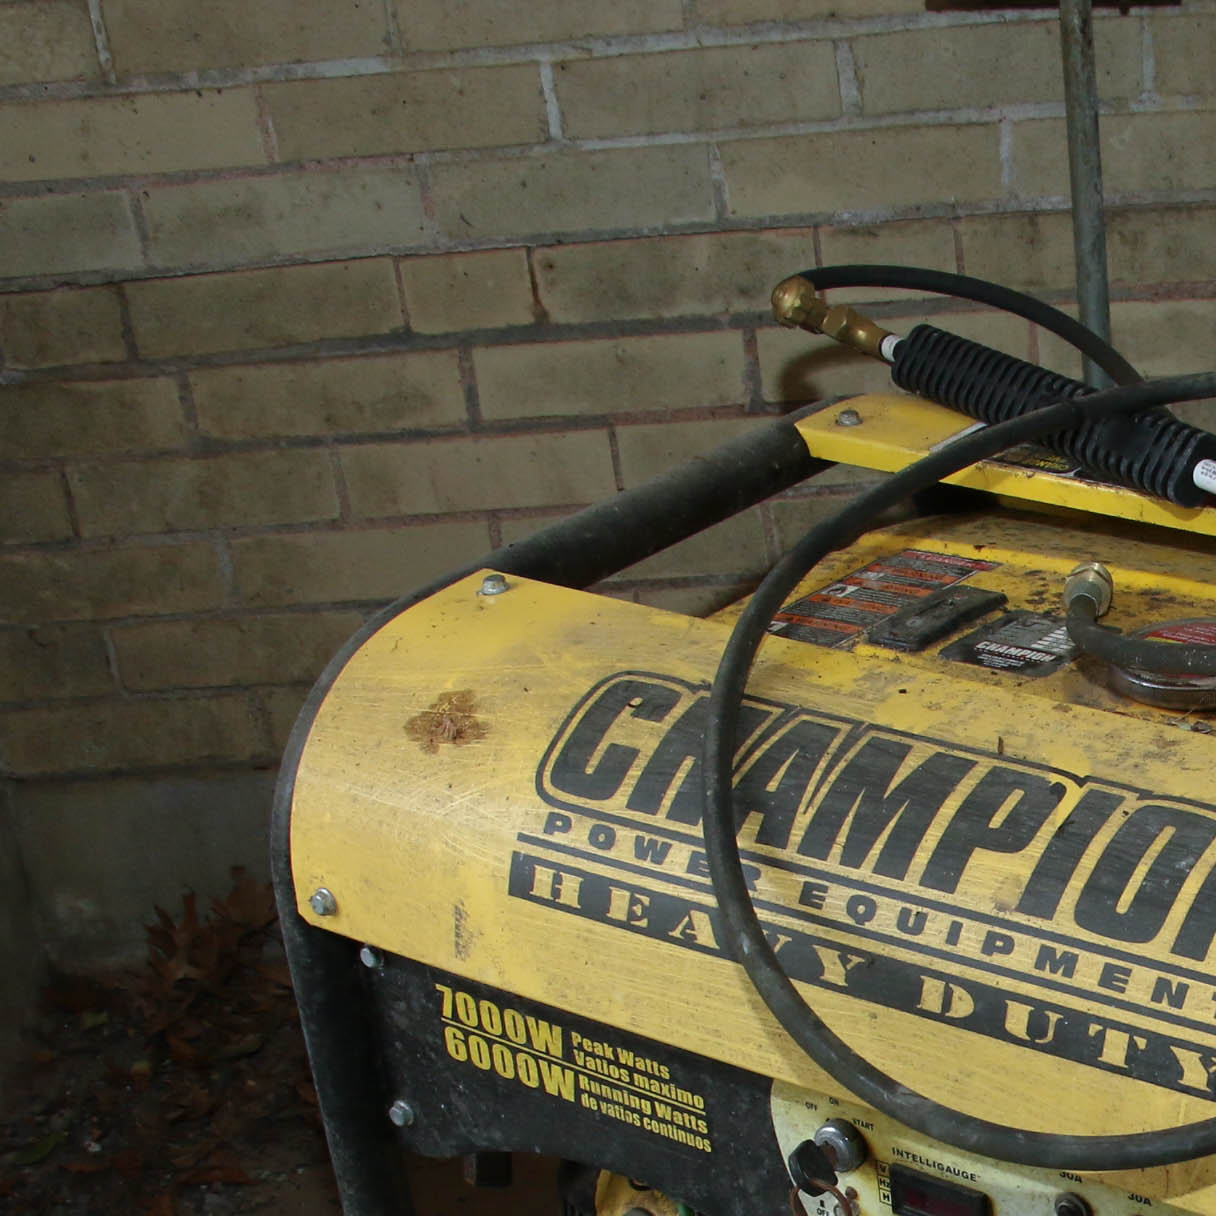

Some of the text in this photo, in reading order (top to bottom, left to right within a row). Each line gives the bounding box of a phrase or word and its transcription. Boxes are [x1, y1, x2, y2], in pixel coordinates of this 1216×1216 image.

[976, 641, 1056, 662] CHAMPION
[435, 983, 562, 1058] 7000W
[444, 1025, 575, 1103] 6000W
[570, 1031, 671, 1080] Peak Watts
[574, 1049, 705, 1109] Vatios maximo
[578, 1073, 709, 1134] Running Watts
[580, 1092, 598, 1112] de
[600, 1099, 641, 1127] vatios
